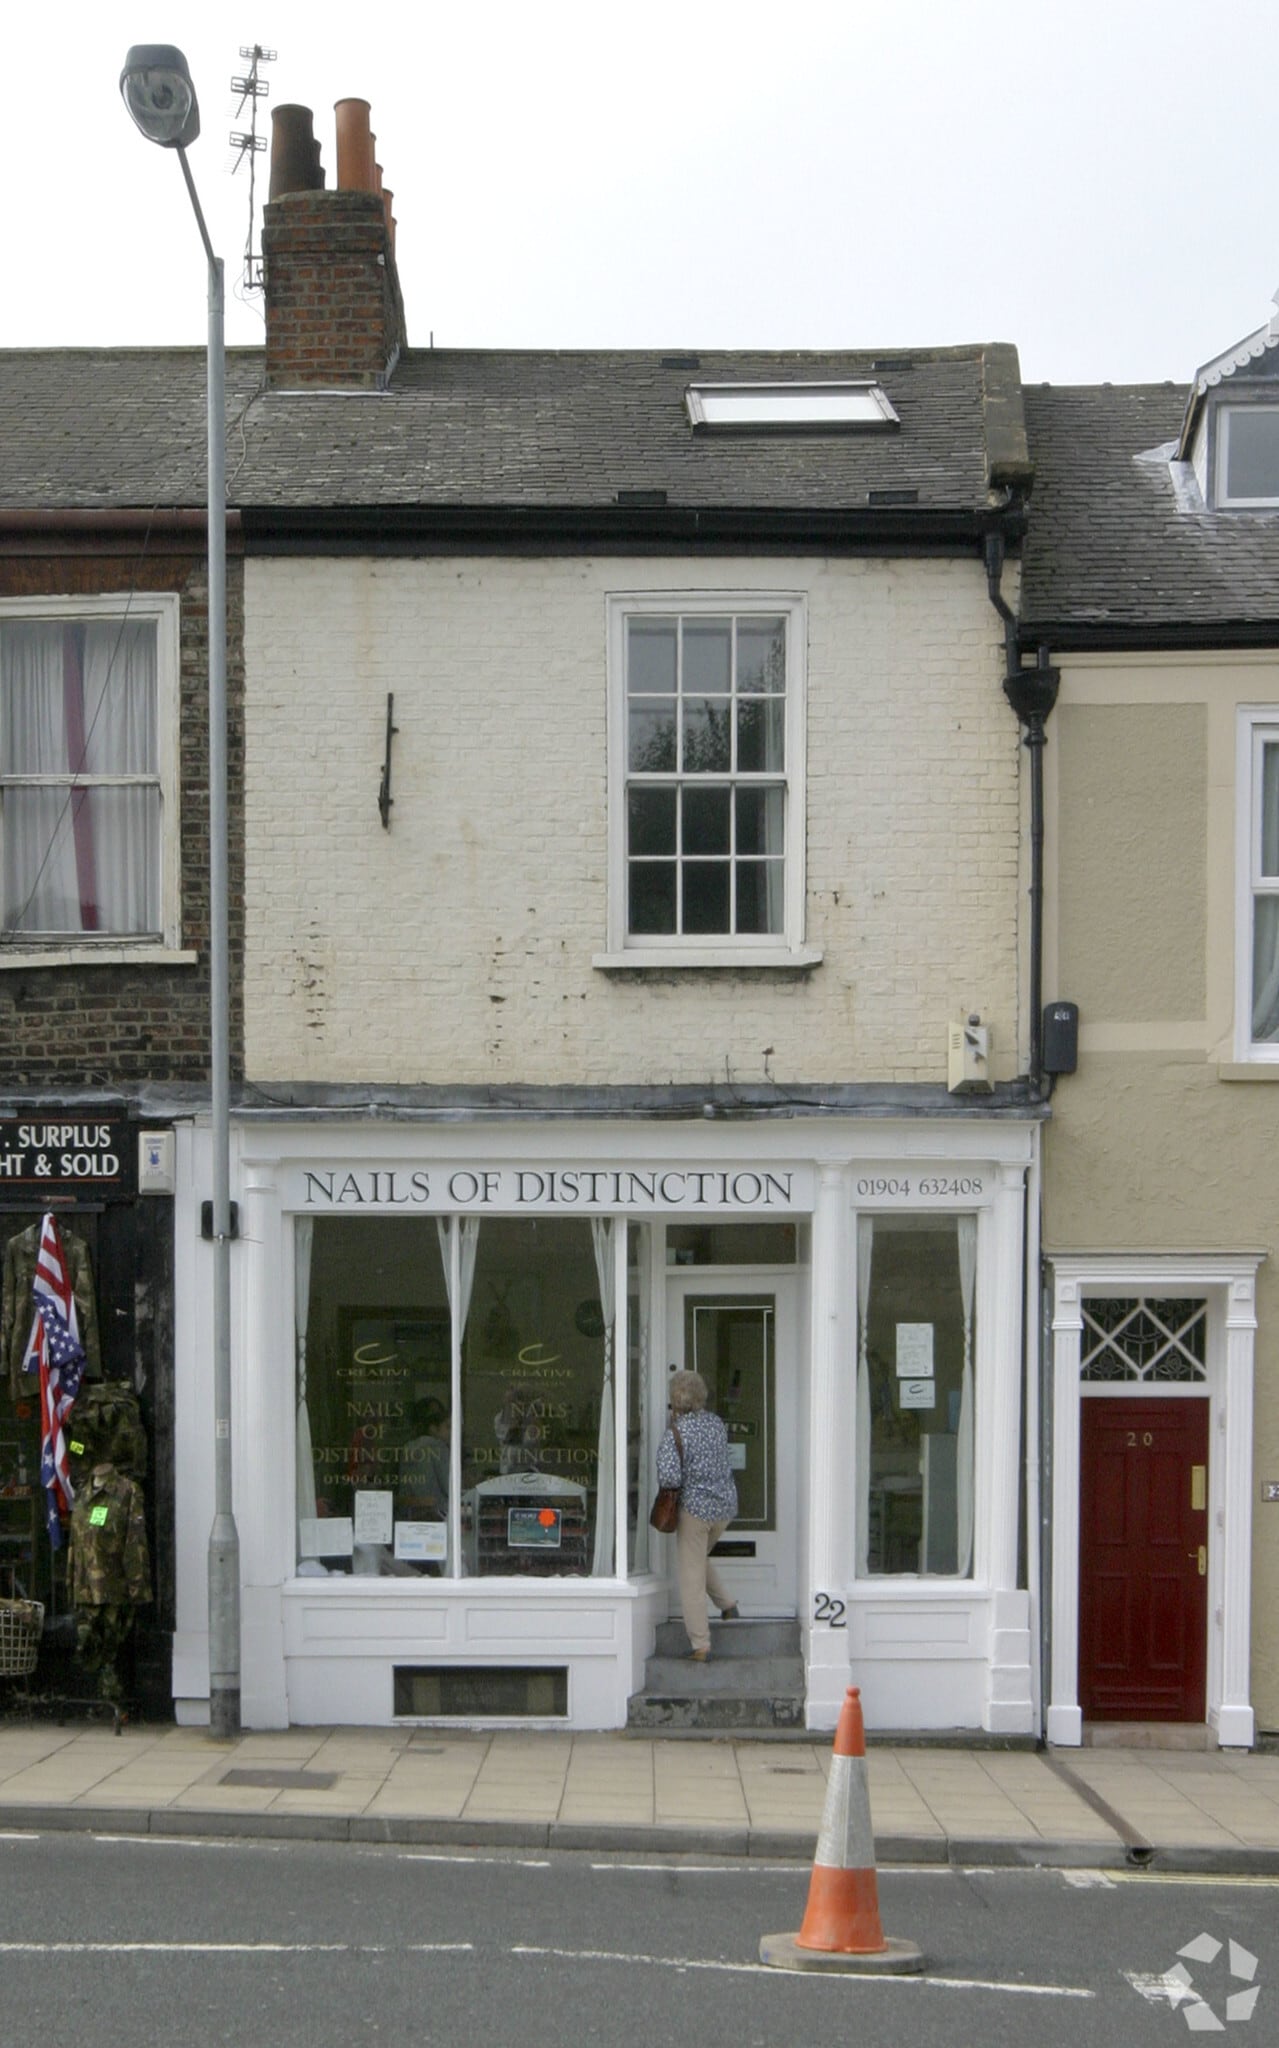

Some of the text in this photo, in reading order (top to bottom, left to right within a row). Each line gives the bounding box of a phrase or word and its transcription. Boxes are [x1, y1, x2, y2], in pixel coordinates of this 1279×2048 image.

[18, 1125, 111, 1148] SURPLUS
[34, 1153, 51, 1176] &
[60, 1153, 119, 1176] SOLD
[303, 1171, 793, 1204] NAILS OF DISTINCTION
[857, 1178, 983, 1196] 01904 632408
[336, 1368, 409, 1377] CREATIVE
[500, 1368, 574, 1377] CREATIVE
[346, 1401, 404, 1417] NAILS
[511, 1402, 568, 1418] NAILS
[362, 1424, 386, 1440] OF
[525, 1425, 550, 1441] OF
[1127, 1431, 1153, 1447] 20
[312, 1447, 442, 1463] DISTINCTION
[814, 1592, 847, 1628] 22
